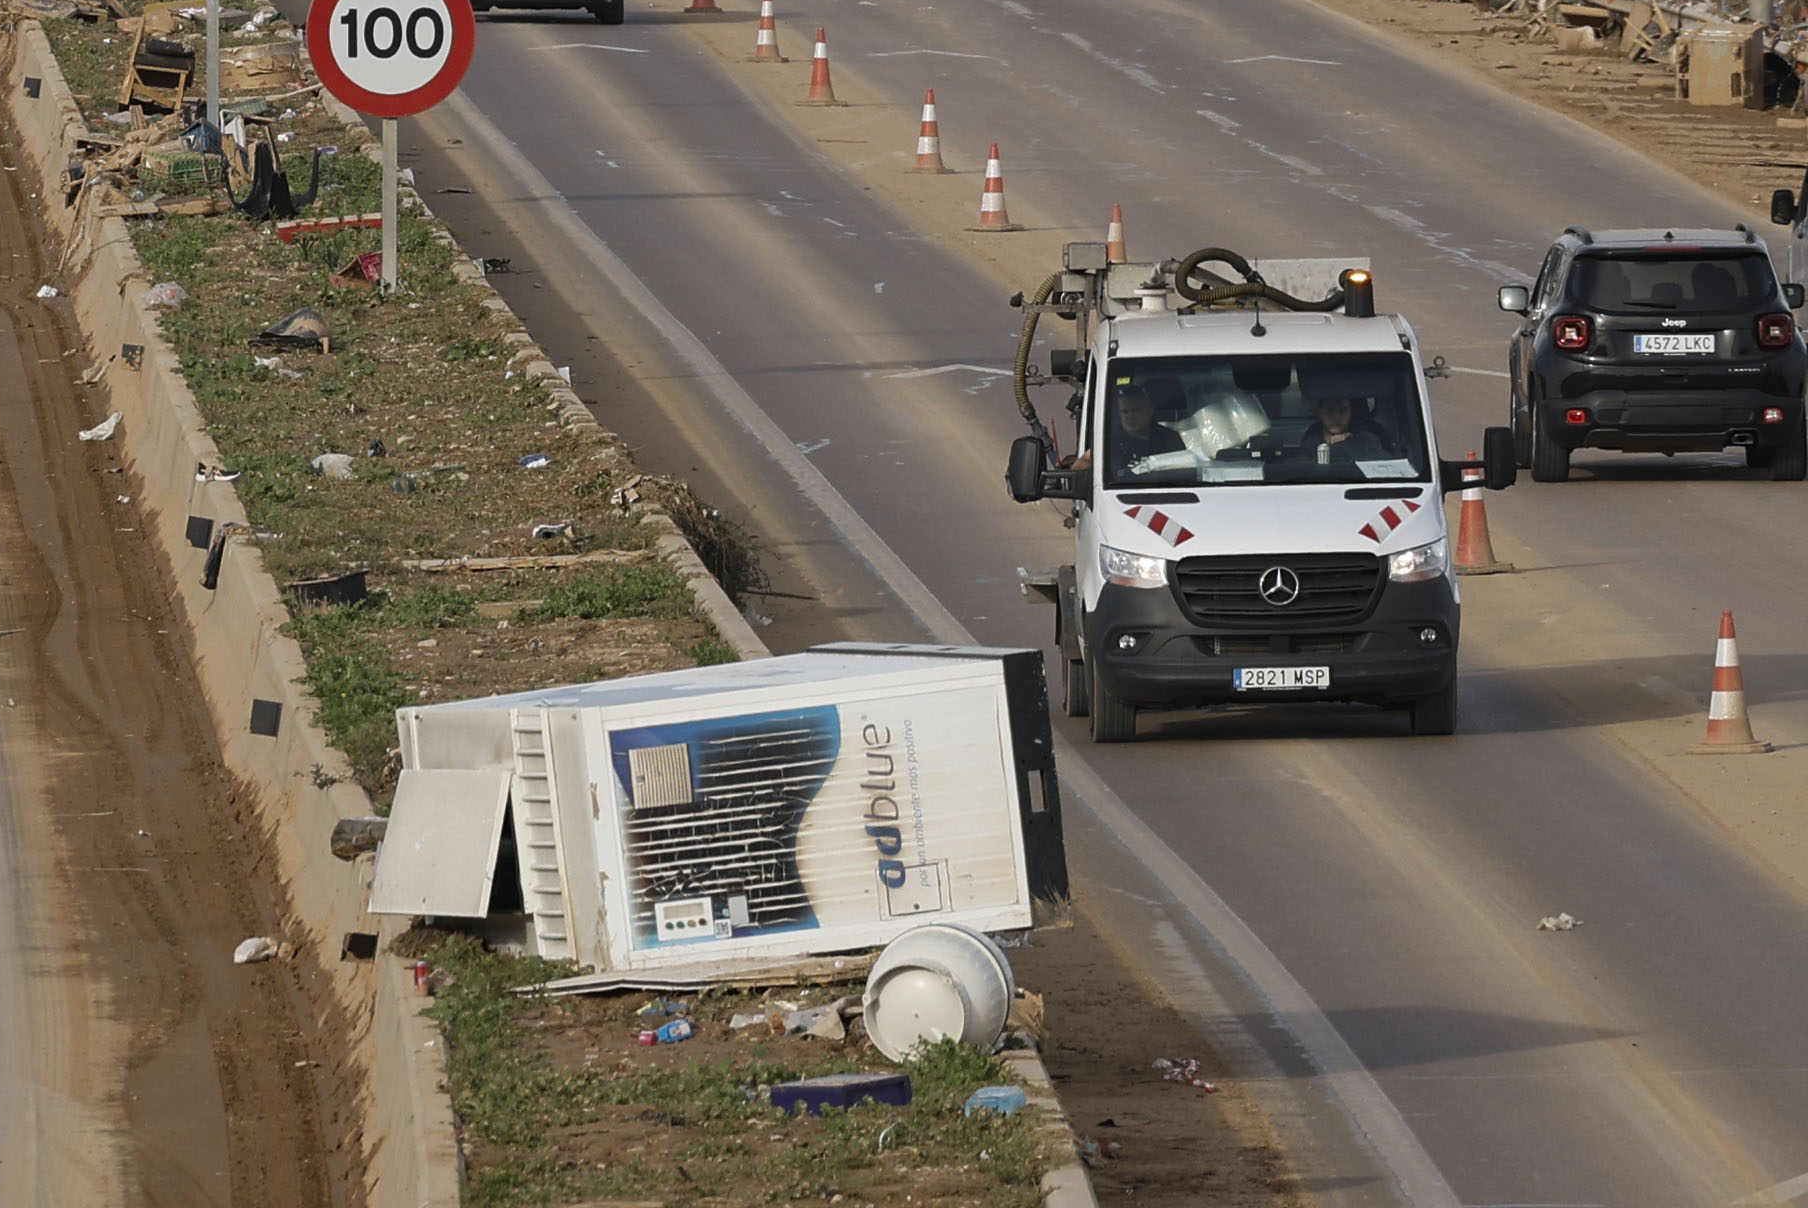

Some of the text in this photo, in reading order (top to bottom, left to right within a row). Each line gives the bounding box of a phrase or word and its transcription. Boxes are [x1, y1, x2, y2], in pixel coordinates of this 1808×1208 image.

[340, 7, 444, 59] 100
[1661, 317, 1687, 328] Jeep
[1644, 336, 1711, 351] 4572 LKC
[1244, 669, 1325, 686] 2821 MSP
[902, 719, 919, 764] positivo
[911, 793, 925, 848] ambiente
